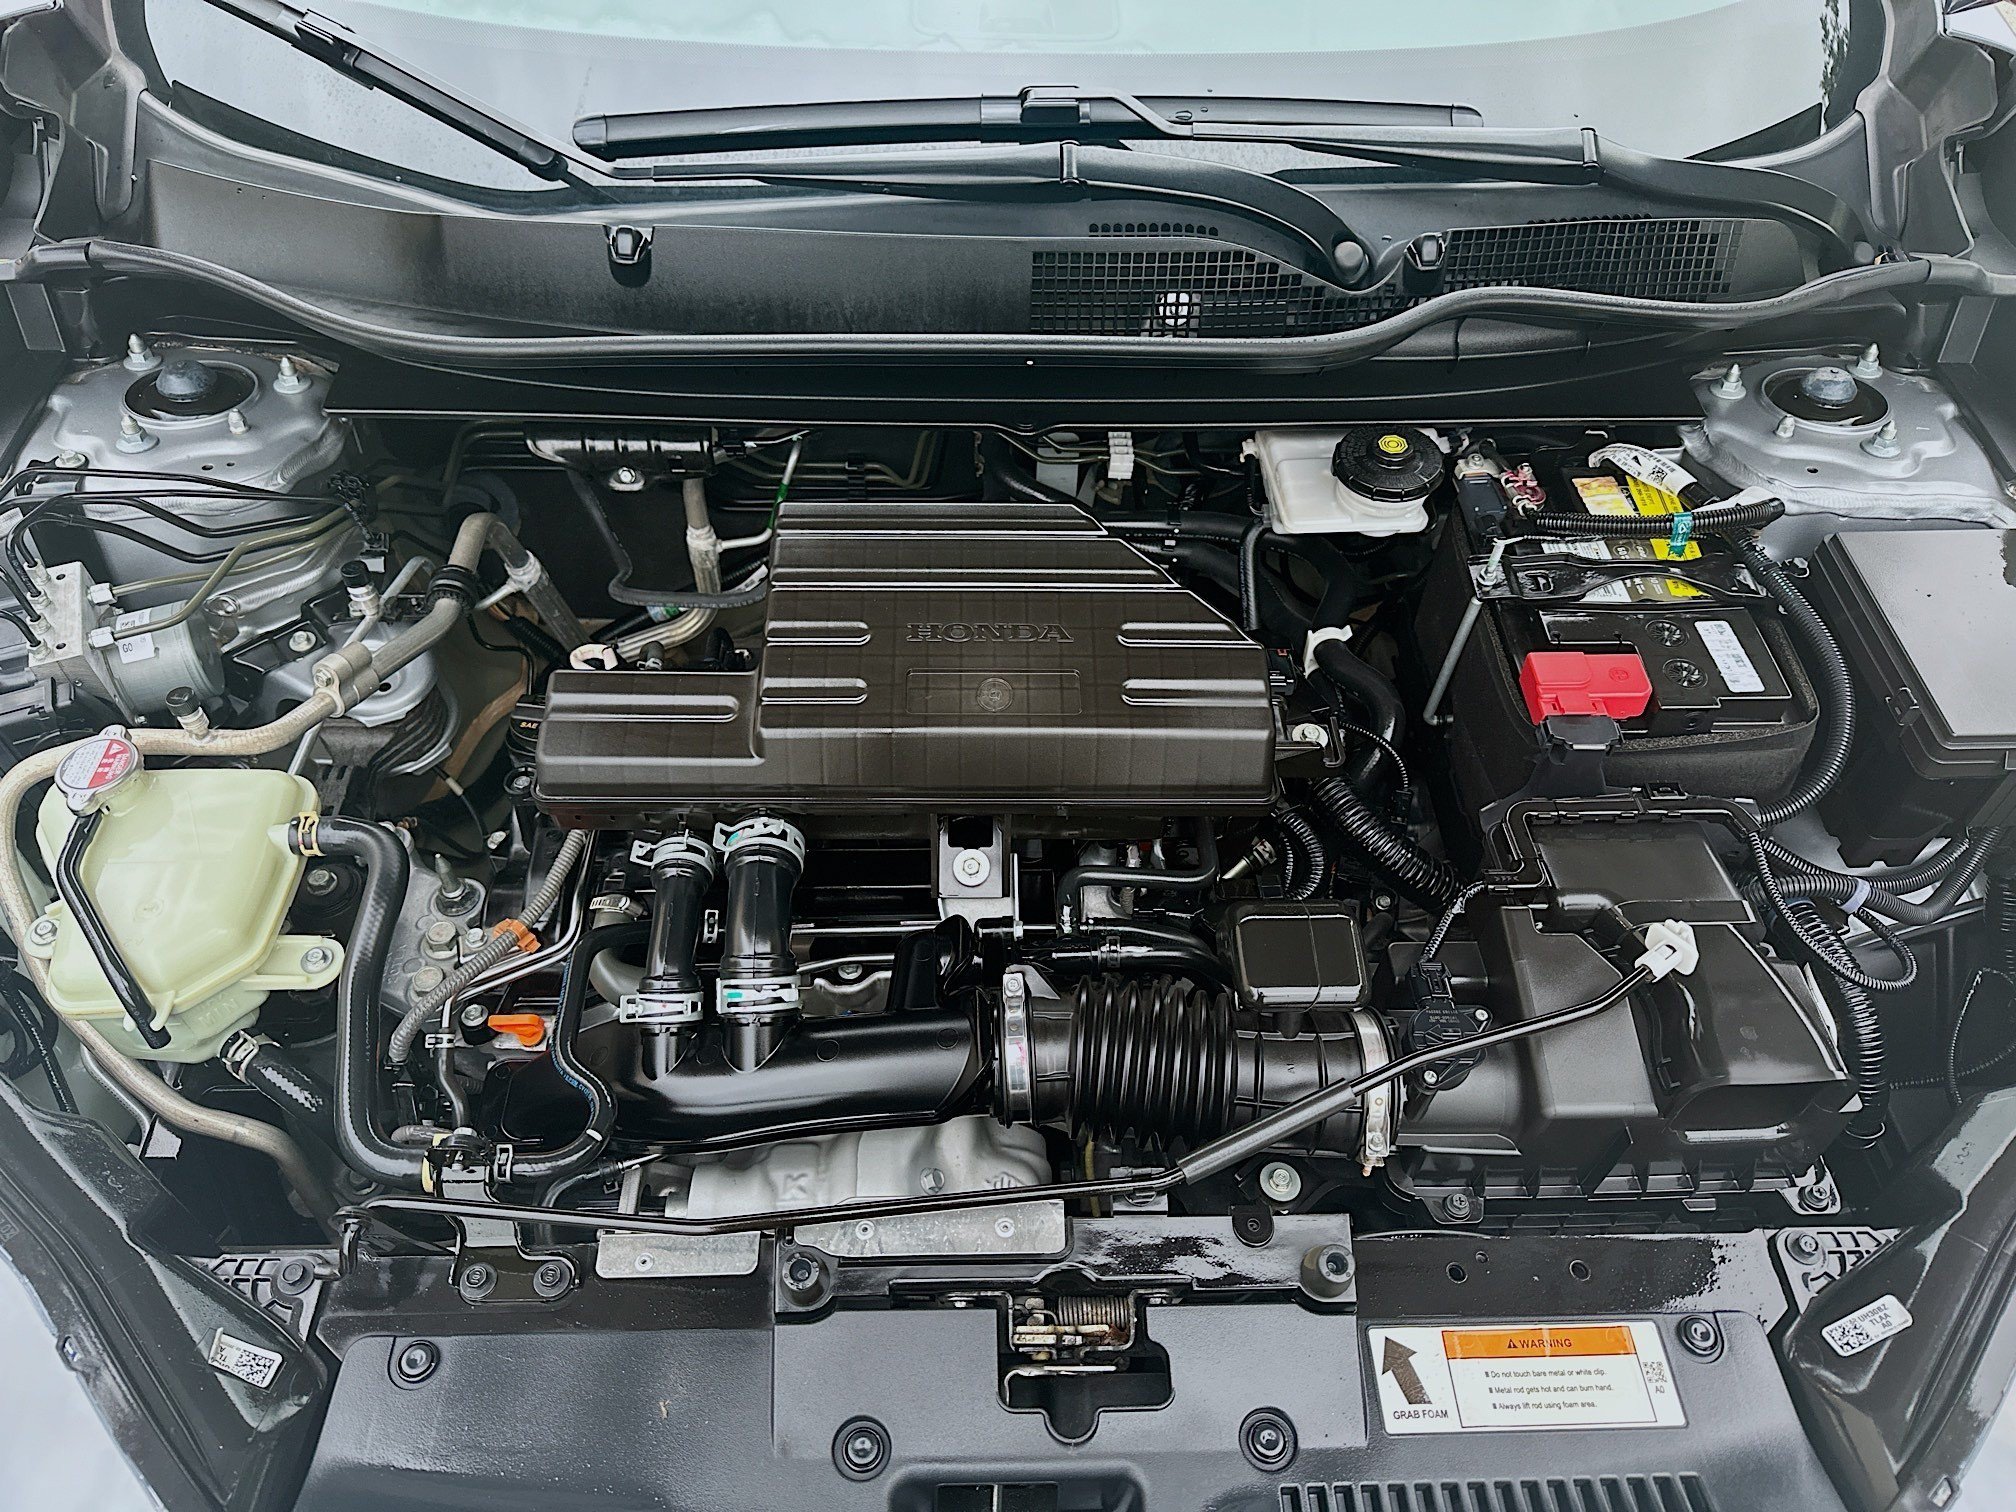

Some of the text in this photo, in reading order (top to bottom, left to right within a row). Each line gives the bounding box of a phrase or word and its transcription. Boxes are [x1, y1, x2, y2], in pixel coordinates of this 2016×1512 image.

[906, 622, 1074, 642] HONDA
[519, 721, 539, 729] SAE
[1518, 1338, 1573, 1349] WARNING
[1526, 1387, 1540, 1395] gets
[1499, 1403, 1521, 1411] Always
[1544, 1402, 1562, 1410] using
[1393, 1409, 1448, 1420] GRAB FOAM
